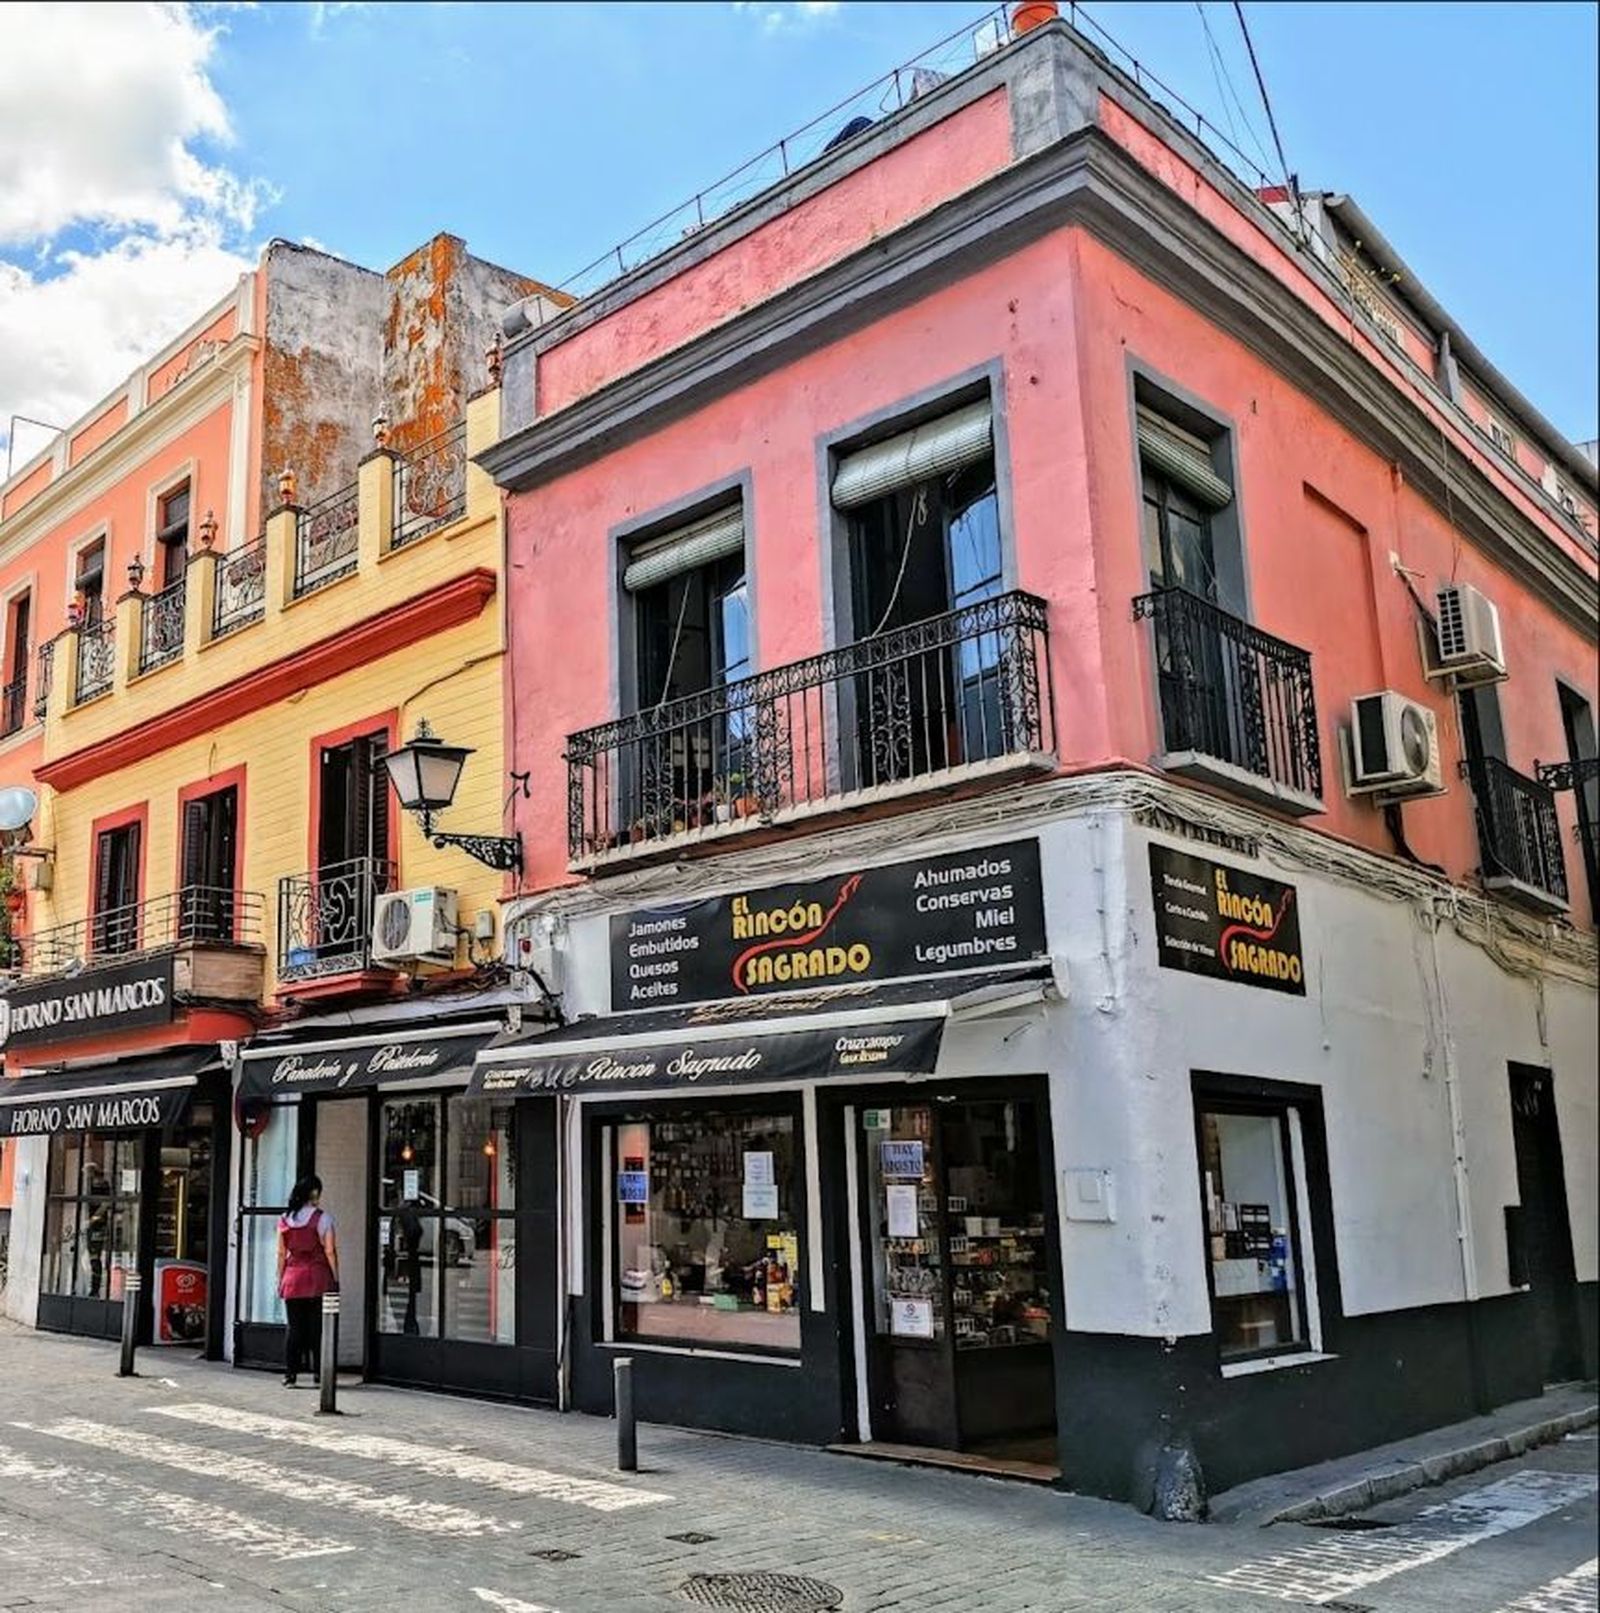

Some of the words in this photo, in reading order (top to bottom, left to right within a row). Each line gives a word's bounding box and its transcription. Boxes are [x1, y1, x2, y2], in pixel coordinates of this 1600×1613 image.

[914, 859, 1012, 888] Ahumados
[1215, 869, 1228, 890] EL
[731, 896, 749, 915] EL
[916, 885, 1014, 912] Conservas
[628, 918, 687, 938] Jamones
[975, 906, 1015, 929] Miel
[629, 936, 699, 958] Embutidos
[915, 936, 1017, 963] Legumbres
[629, 960, 679, 979] Quesos
[746, 943, 871, 986] SAGRADO
[1230, 940, 1301, 983] SAGRADO
[630, 981, 678, 1000] Aceites
[11, 999, 62, 1034] HORNO
[63, 991, 95, 1021] SAN
[96, 977, 166, 1017] MARCOS
[337, 1062, 358, 1087] y
[580, 1055, 656, 1081] Rincón
[666, 1047, 762, 1081] Sagrado
[11, 1106, 61, 1133] HORNO
[65, 1103, 94, 1129] SAN
[97, 1096, 161, 1127] MARCOS
